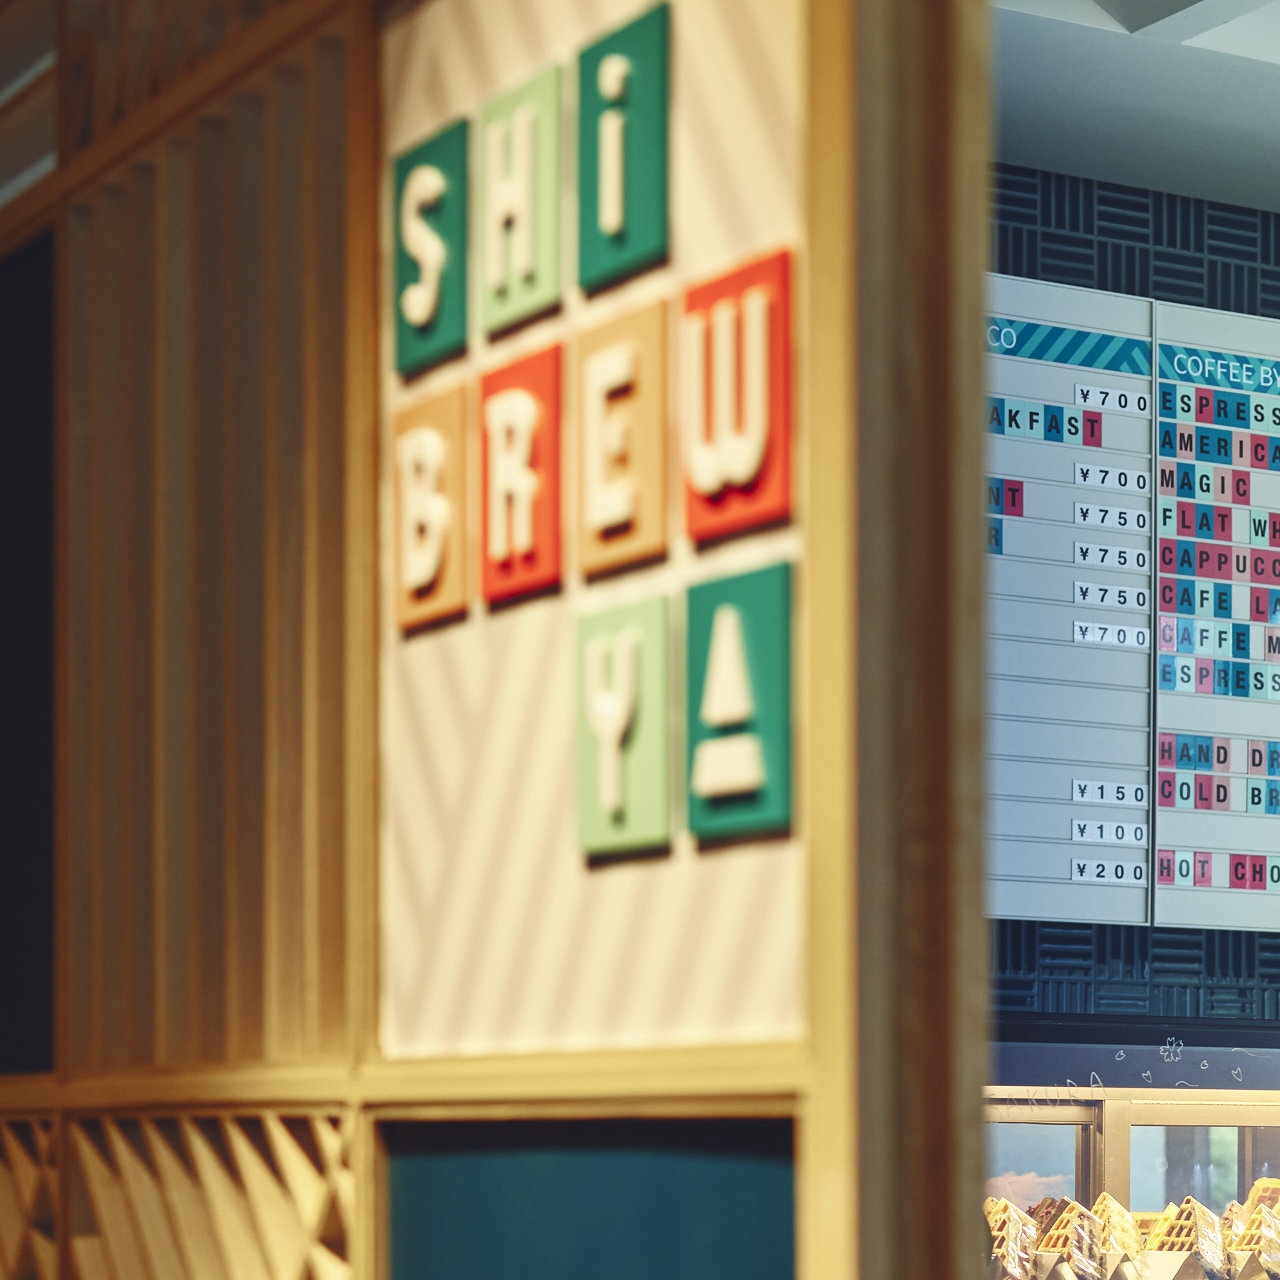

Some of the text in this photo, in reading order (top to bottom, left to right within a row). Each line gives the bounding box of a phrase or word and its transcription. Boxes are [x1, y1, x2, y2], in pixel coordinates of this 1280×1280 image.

[1173, 353, 1254, 385] COFFEE
[396, 284, 776, 594] BREW
[1161, 470, 1247, 497] MAGIC
[1163, 509, 1229, 533] FLAT
[1162, 585, 1229, 612] CAFE
[1162, 624, 1247, 652] CAFFE
[1160, 741, 1228, 766] HAND
[1161, 780, 1228, 804] COLD
[1159, 855, 1210, 879] HOT
